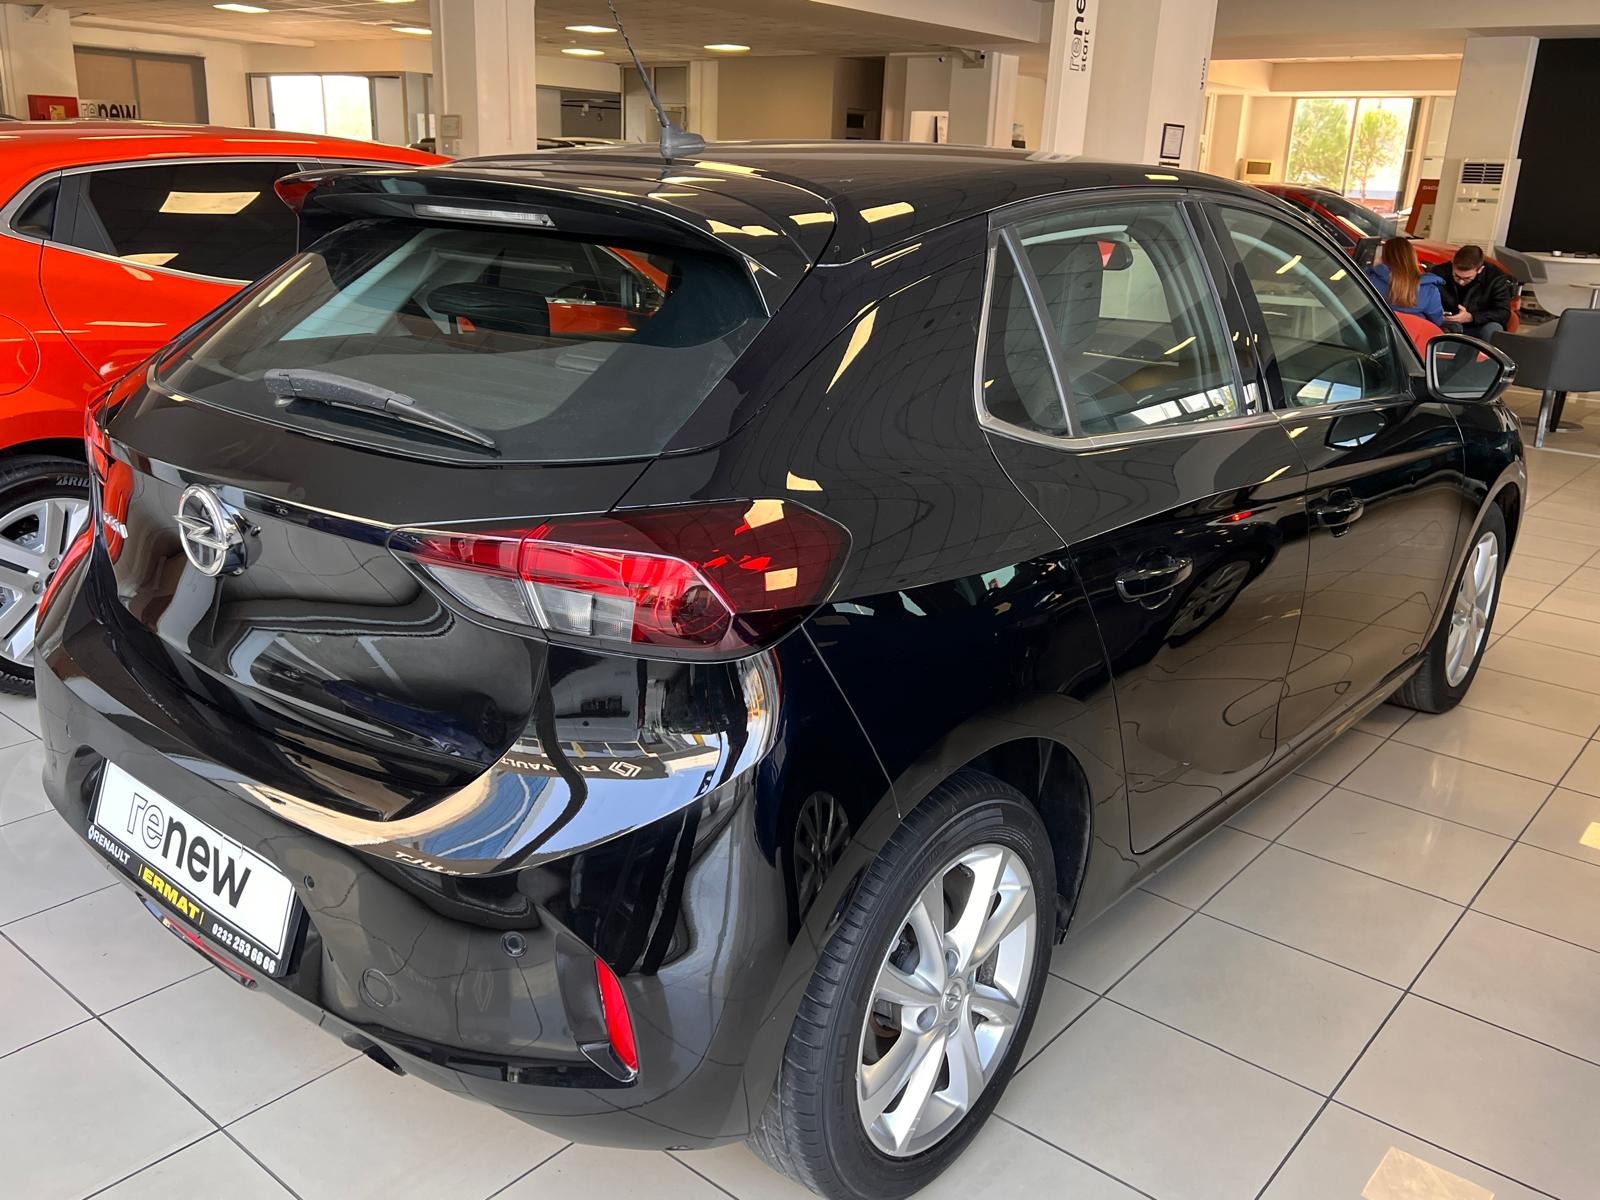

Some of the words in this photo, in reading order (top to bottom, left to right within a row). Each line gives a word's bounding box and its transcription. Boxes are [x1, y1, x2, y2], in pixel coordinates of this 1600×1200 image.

[1081, 30, 1090, 71] start
[80, 103, 136, 118] renew
[93, 831, 130, 865] RENAULT
[127, 793, 251, 908] renew
[142, 869, 200, 919] ERMAT
[212, 923, 233, 945] 0232
[233, 936, 251, 956] 253
[251, 948, 263, 965] 66
[263, 956, 275, 974] 66
